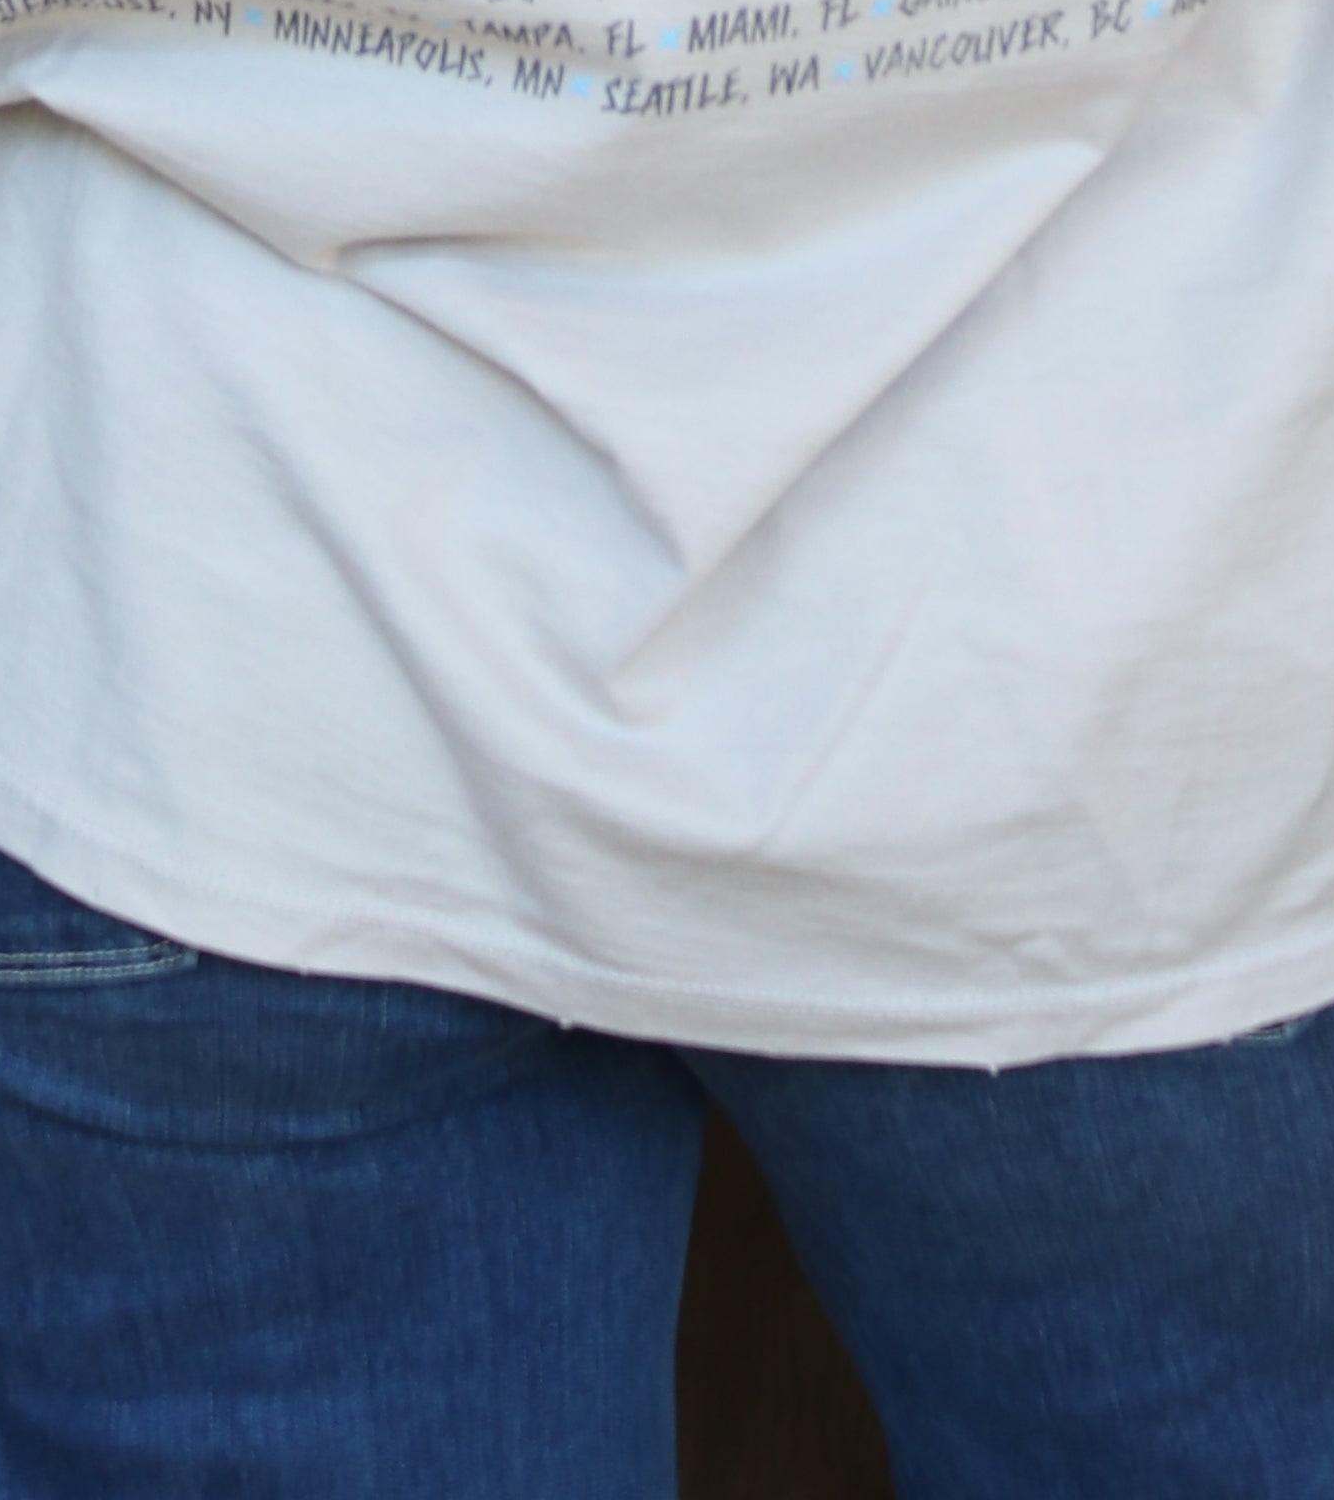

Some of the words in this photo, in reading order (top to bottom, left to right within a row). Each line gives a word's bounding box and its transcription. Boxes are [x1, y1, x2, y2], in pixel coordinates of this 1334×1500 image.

[193, 0, 234, 37] NY
[513, 54, 566, 102] MN
[769, 52, 823, 97] WA
[604, 17, 647, 60] FL
